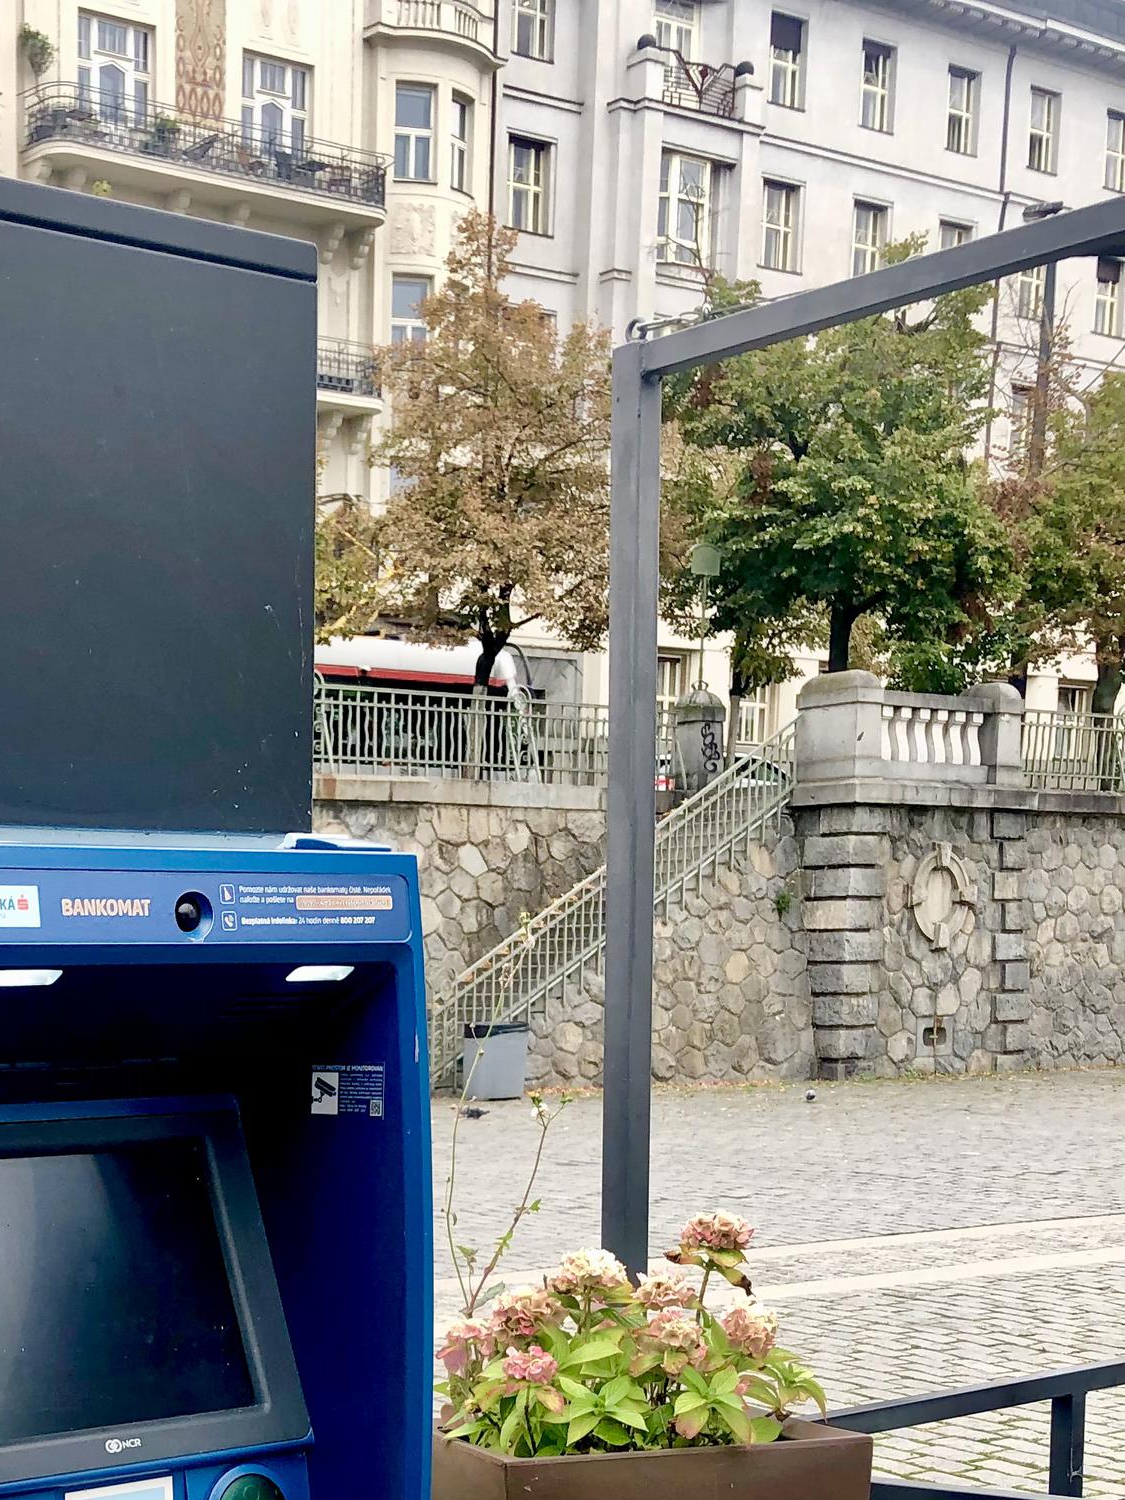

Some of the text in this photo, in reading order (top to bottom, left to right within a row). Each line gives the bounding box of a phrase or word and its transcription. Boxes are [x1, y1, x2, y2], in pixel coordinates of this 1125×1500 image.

[317, 886, 348, 895] bankomaty
[61, 898, 151, 917] BANKOMAT
[122, 1438, 142, 1449] NCR
